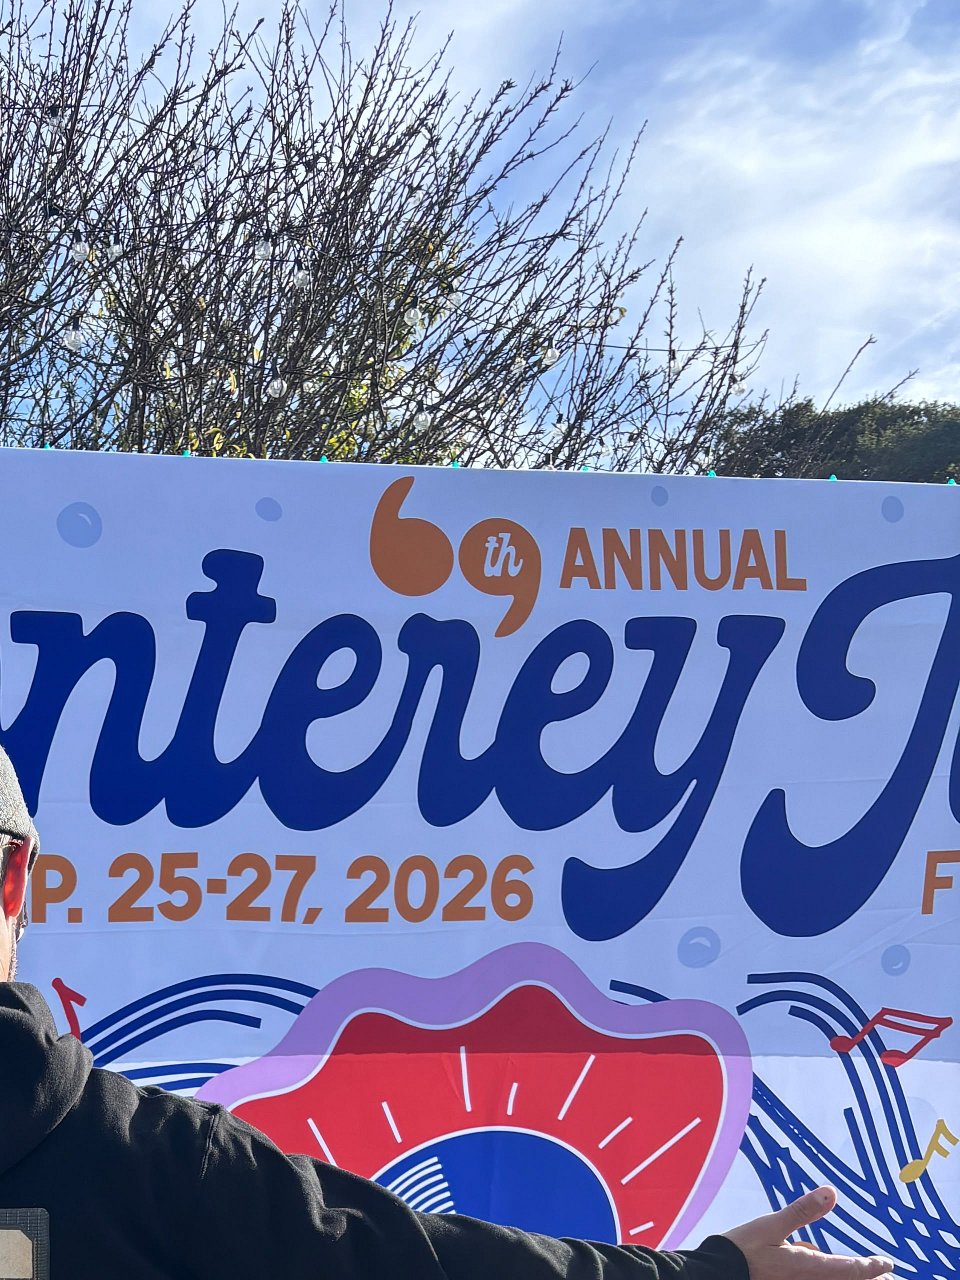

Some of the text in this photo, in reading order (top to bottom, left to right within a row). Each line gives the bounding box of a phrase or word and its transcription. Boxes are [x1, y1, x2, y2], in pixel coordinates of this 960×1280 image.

[559, 527, 808, 592] ANNUAL
[30, 851, 536, 925] P. 25-27, 2026
